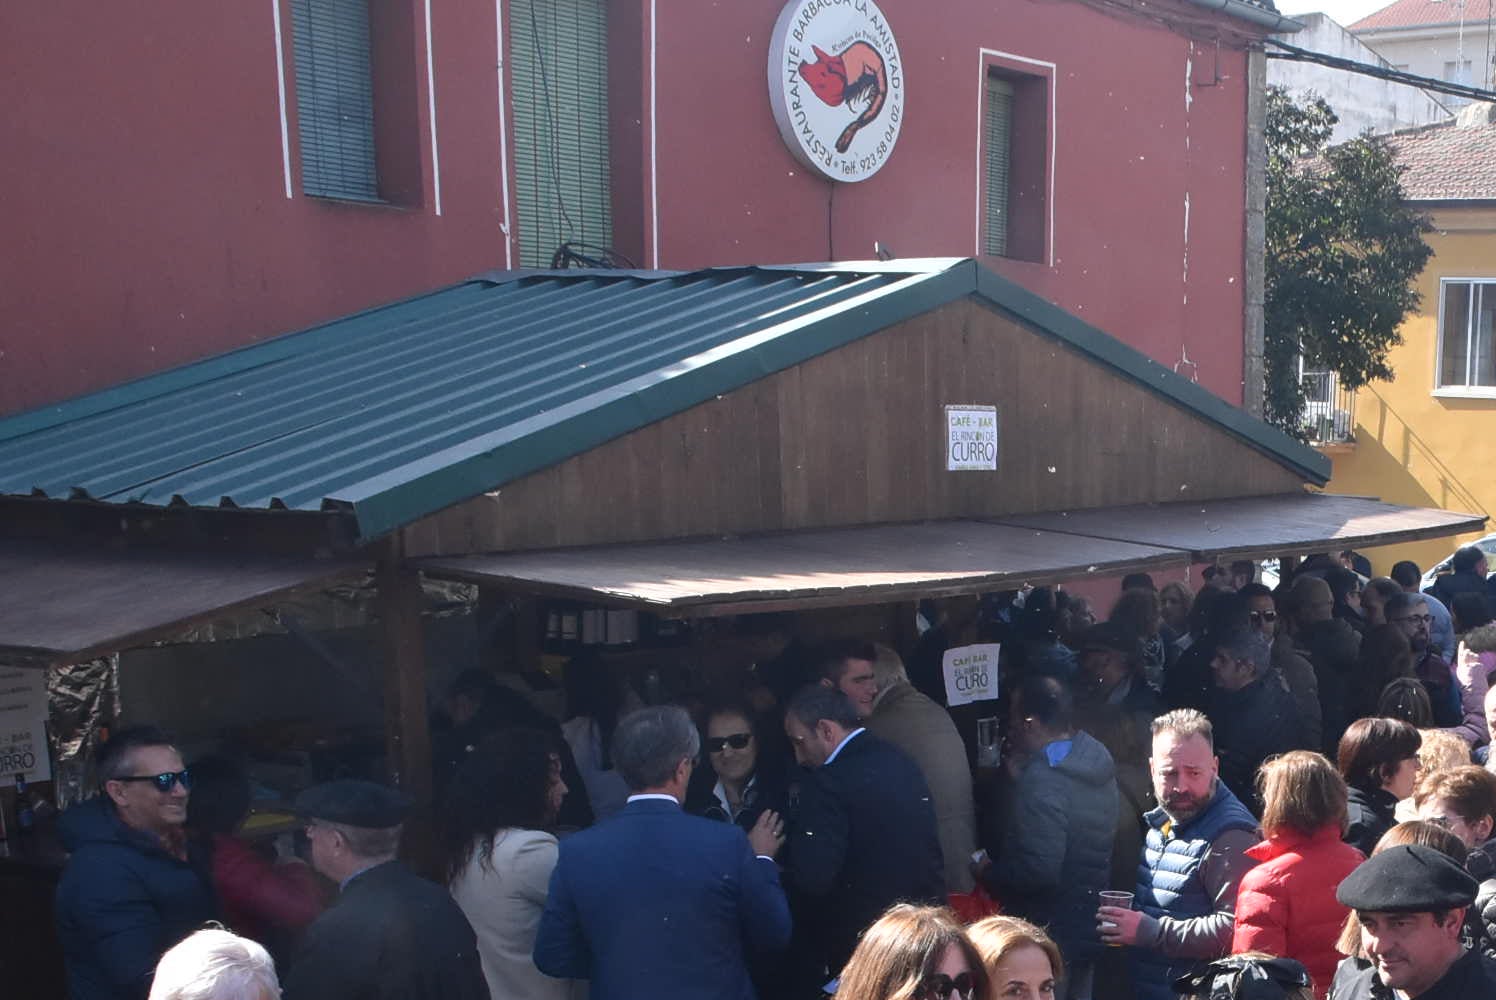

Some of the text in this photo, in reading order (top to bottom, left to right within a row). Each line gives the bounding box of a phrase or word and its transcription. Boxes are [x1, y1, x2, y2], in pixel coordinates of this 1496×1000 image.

[788, 46, 833, 167] RESTAURANTE
[870, 15, 900, 89] AMISTAD
[841, 105, 901, 175] Telf. 923 58 04 02
[952, 442, 994, 461] CURRO
[0, 752, 35, 773] RRO
